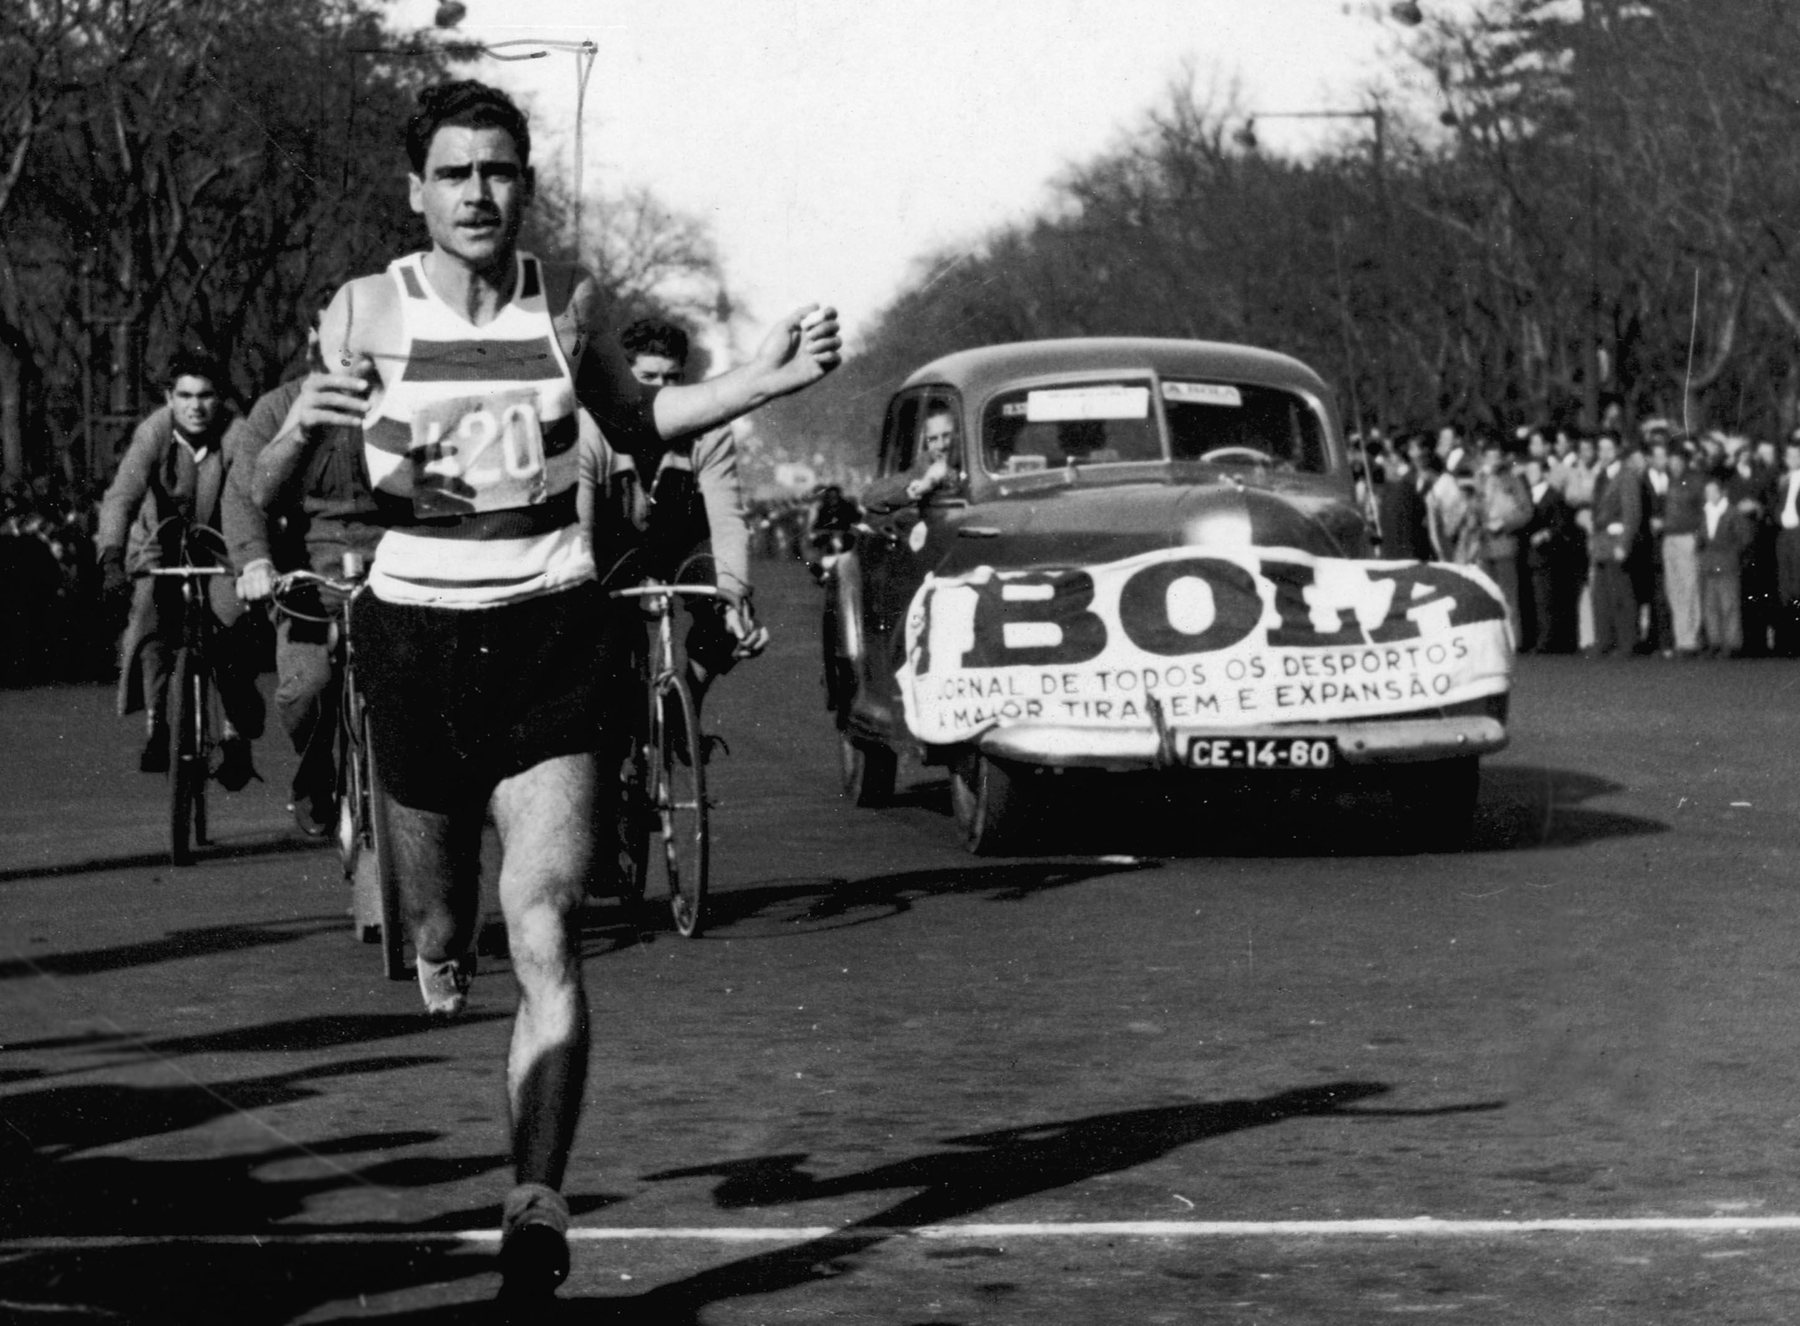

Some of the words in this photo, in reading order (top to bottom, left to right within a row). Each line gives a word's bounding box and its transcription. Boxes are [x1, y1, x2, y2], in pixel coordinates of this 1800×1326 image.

[960, 556, 1506, 669] BOLA
[937, 675, 1024, 701] ORNAL
[1041, 672, 1079, 695] DE
[1096, 663, 1206, 691] TODOS
[1225, 655, 1266, 680] OS
[1283, 636, 1468, 677] DESPORTOS
[1062, 694, 1220, 719] TIRAEM
[1238, 688, 1257, 711] E
[1275, 672, 1451, 708] EXPANSÃO
[1192, 740, 1330, 768] CE-14-60
